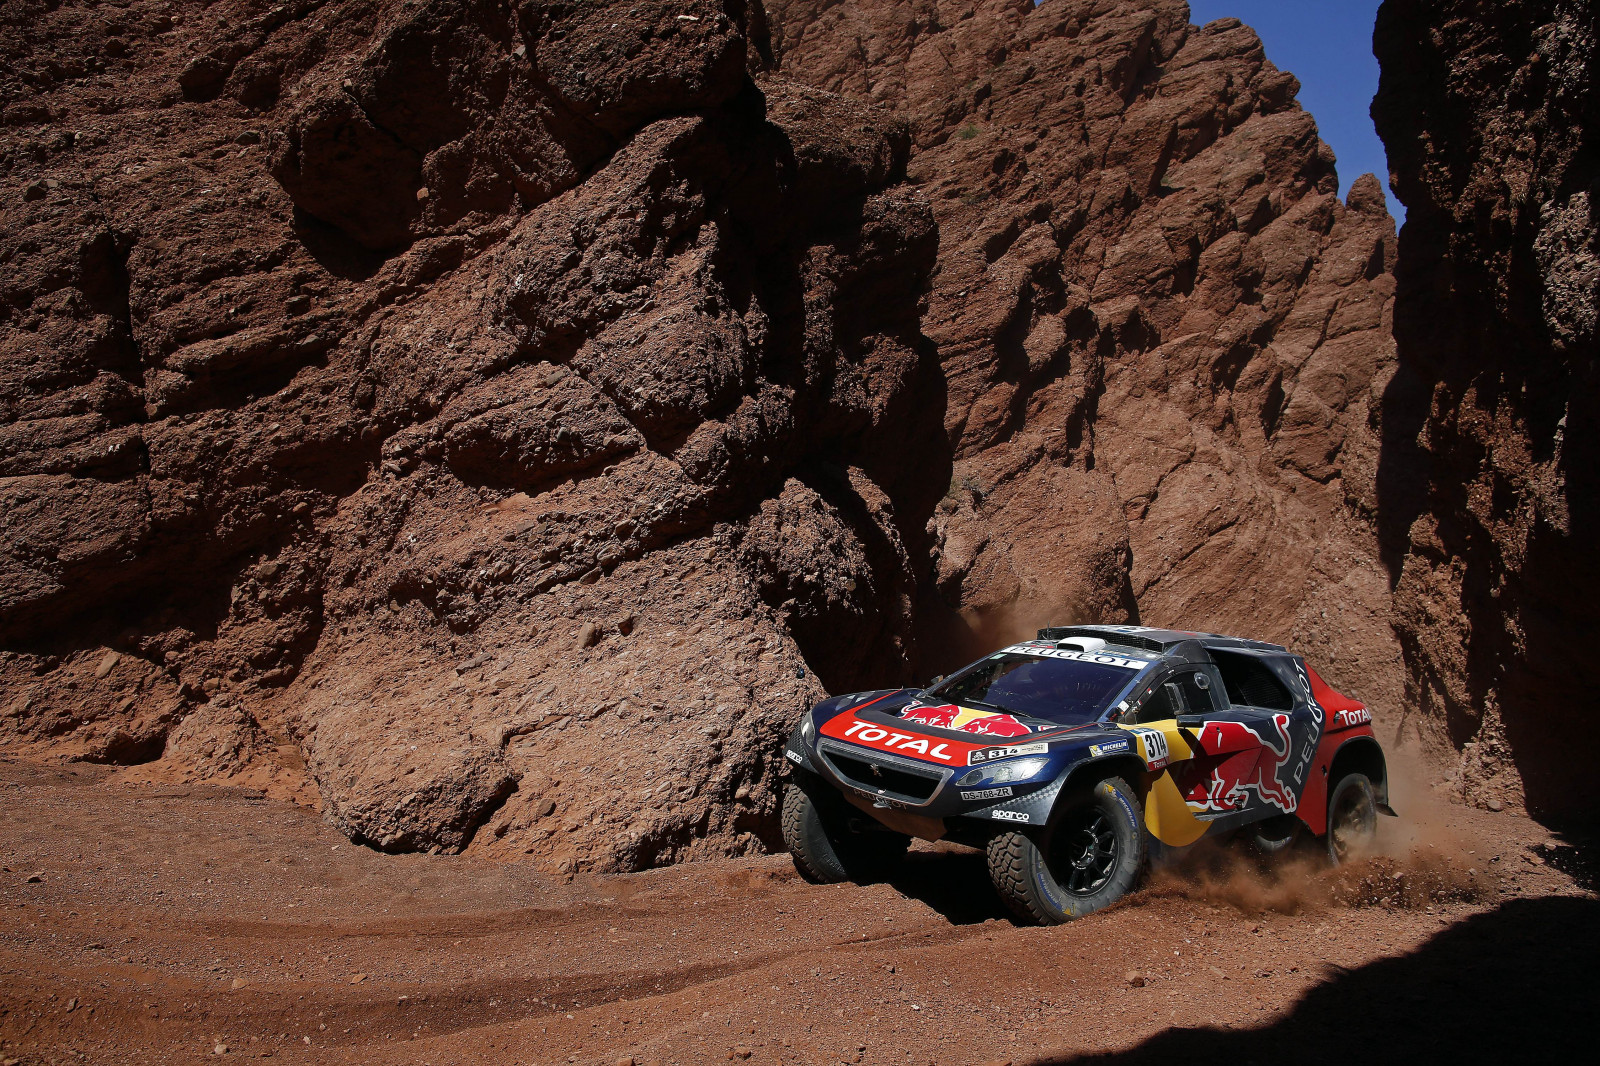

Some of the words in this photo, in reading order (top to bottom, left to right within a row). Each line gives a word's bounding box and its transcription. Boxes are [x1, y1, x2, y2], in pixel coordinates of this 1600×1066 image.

[1010, 646, 1138, 667] PEUGEOT
[1292, 657, 1323, 785] PEUGEOT
[844, 720, 952, 760] TOTAL
[1102, 741, 1127, 752] MICHELIN
[1145, 731, 1167, 758] 314
[991, 748, 1018, 758] 314
[963, 787, 1010, 800] DS-768-ZR
[992, 809, 1029, 821] sparco
